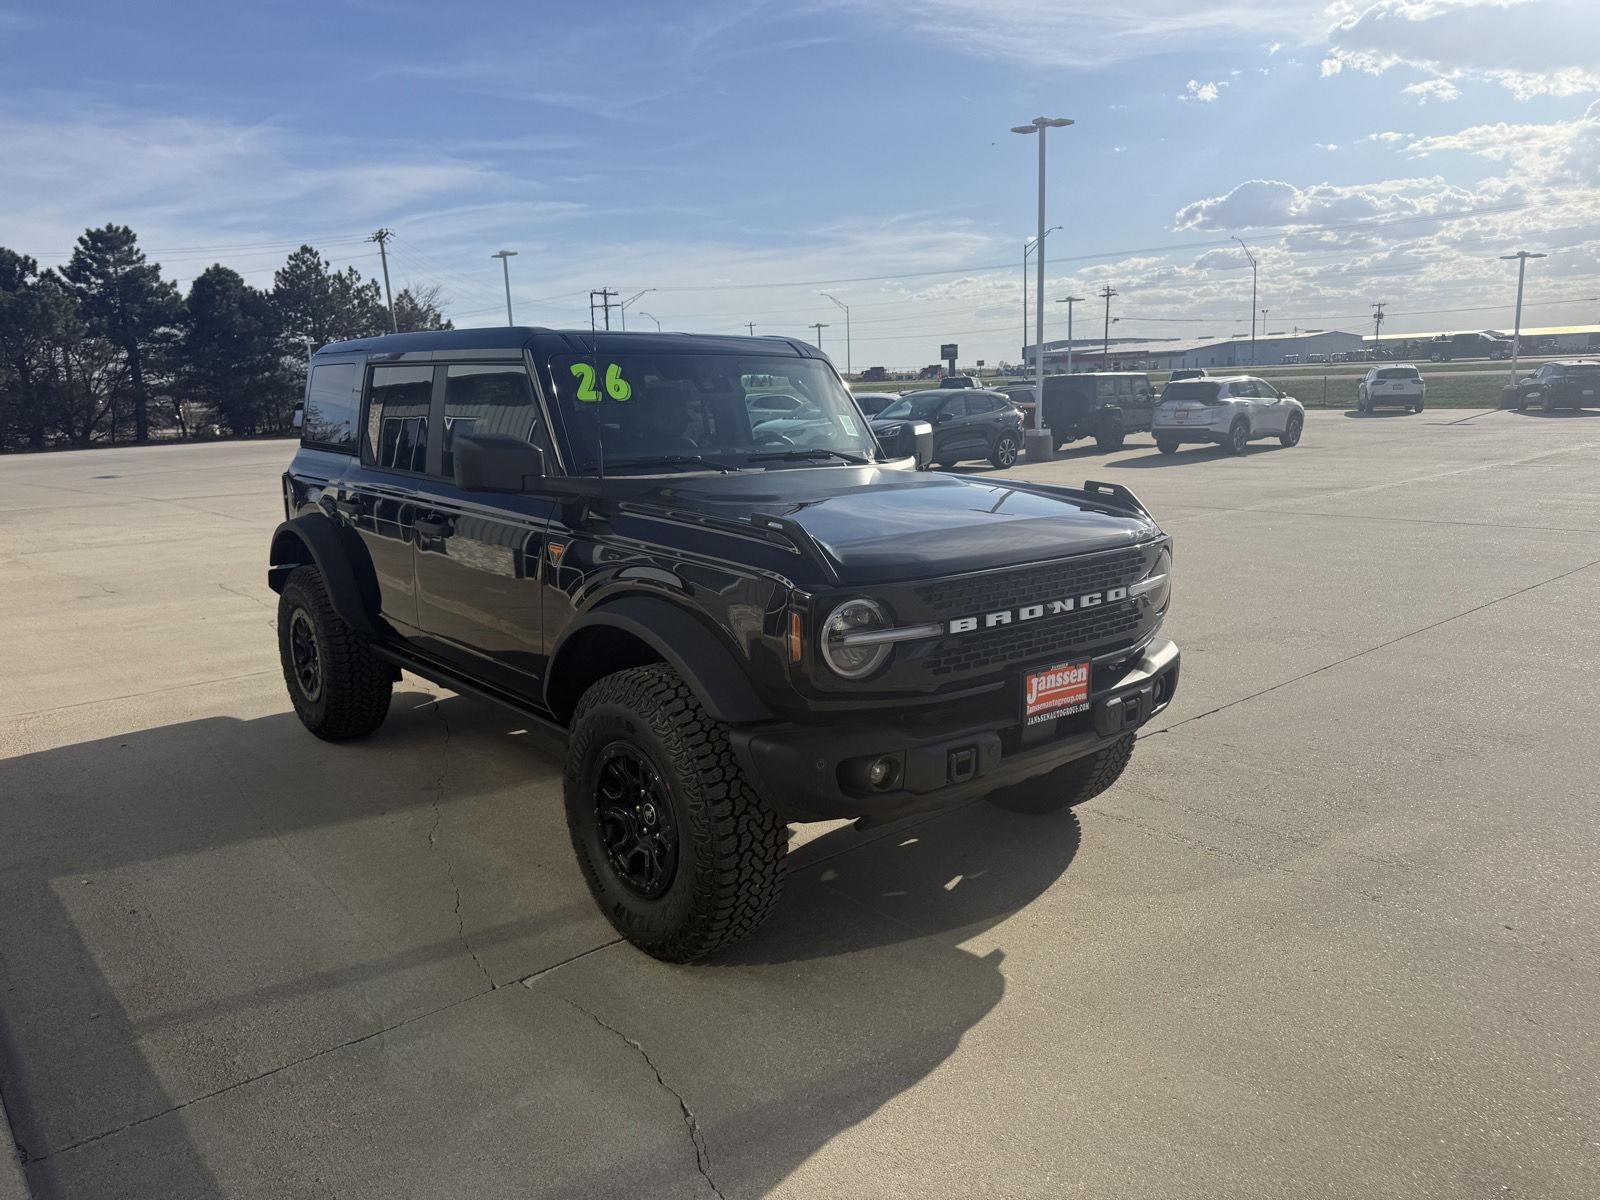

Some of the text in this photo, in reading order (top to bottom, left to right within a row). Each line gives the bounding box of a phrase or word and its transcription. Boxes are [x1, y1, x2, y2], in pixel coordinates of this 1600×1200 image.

[570, 363, 631, 402] 26
[949, 587, 1126, 634] BRONCO
[1026, 667, 1087, 704] Janssen
